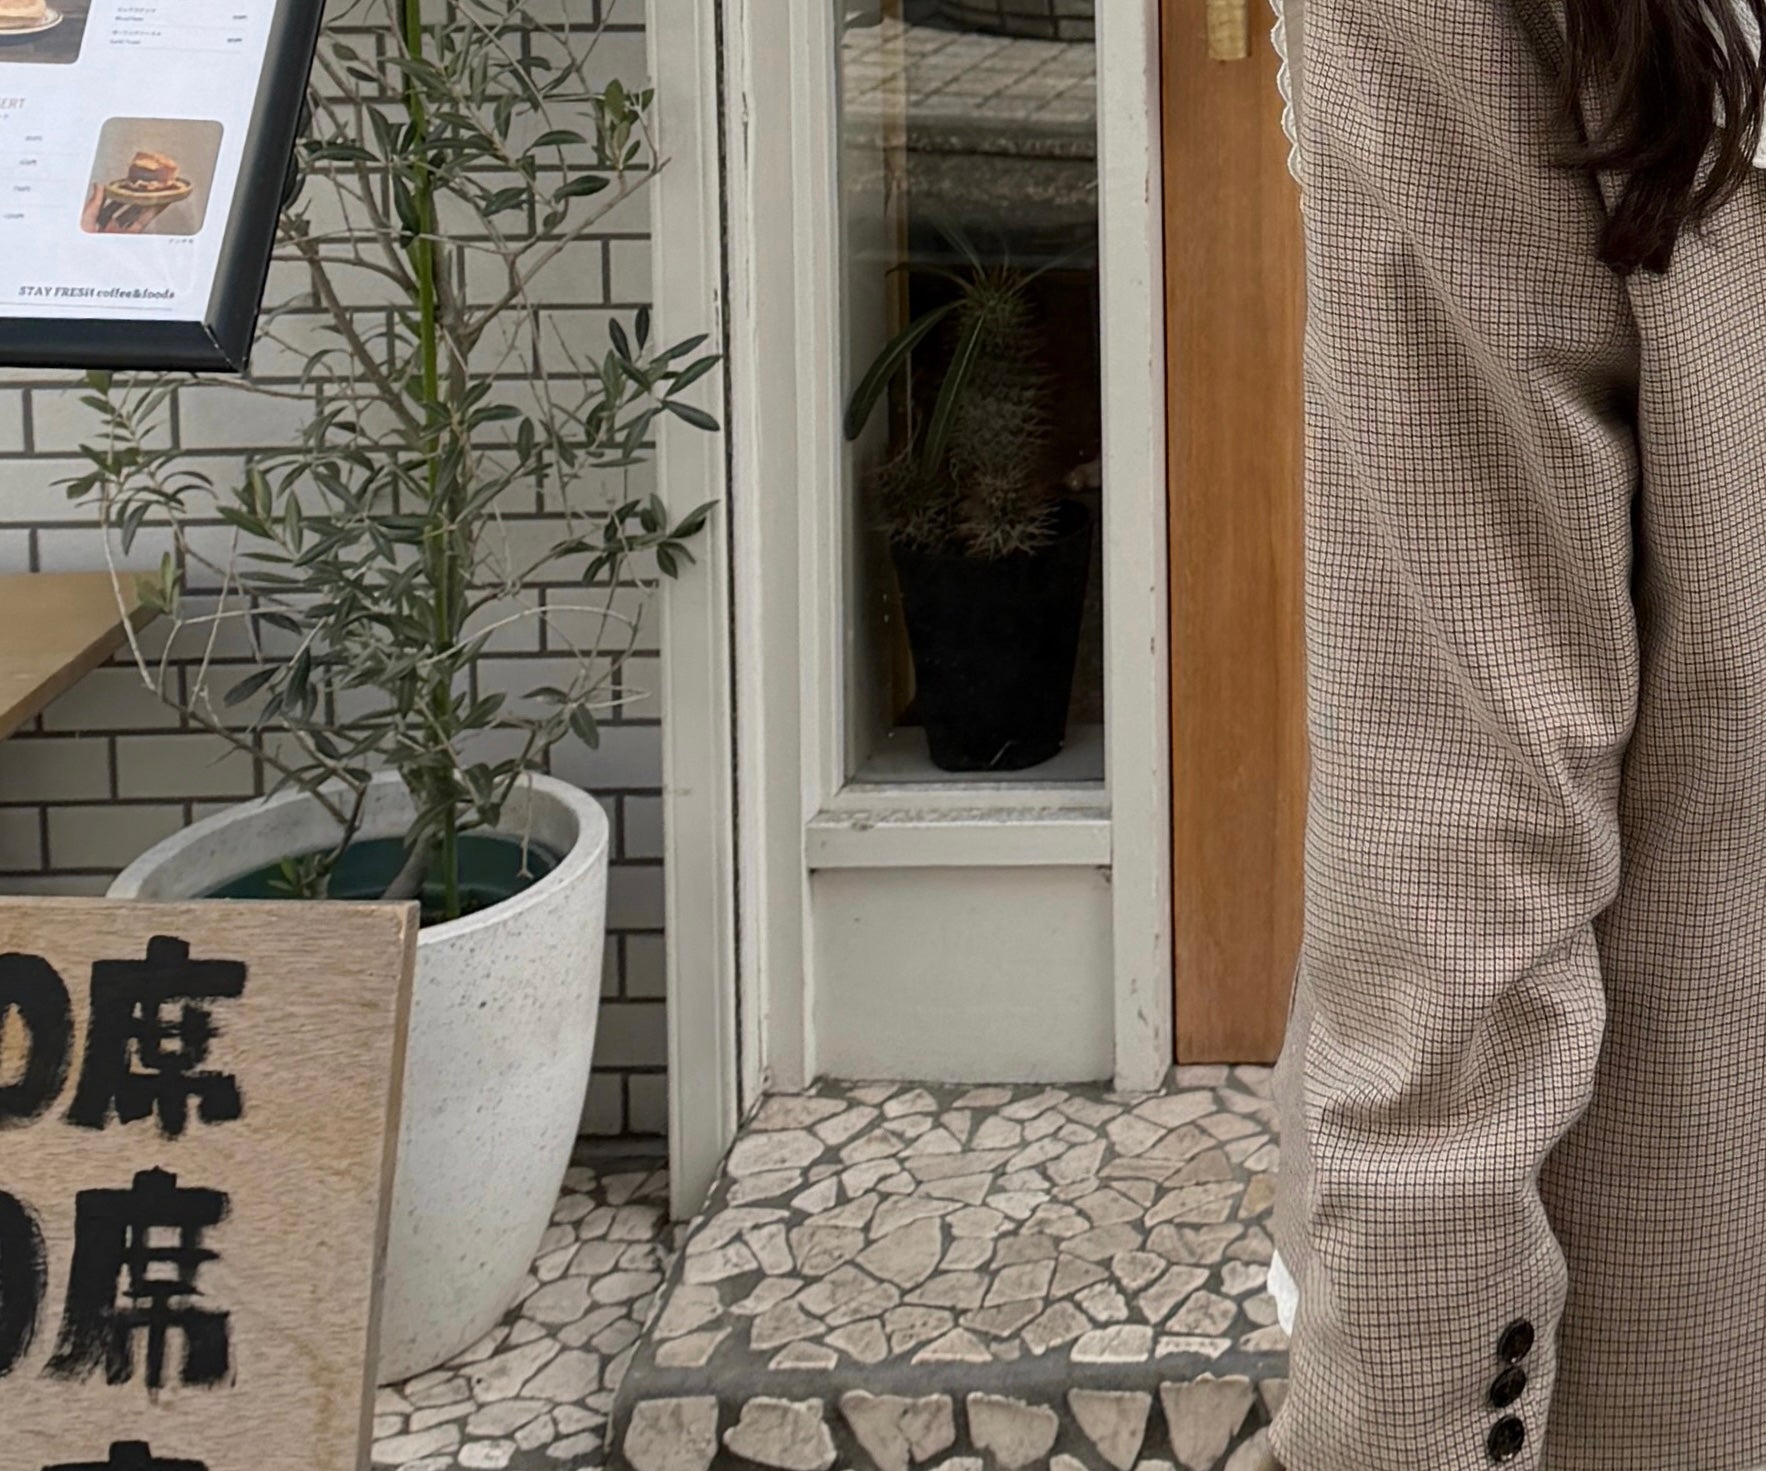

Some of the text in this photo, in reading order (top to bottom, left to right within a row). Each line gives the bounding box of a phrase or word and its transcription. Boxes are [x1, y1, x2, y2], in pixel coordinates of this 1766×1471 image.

[18, 285, 52, 297] STAY
[54, 287, 95, 298] FRESH
[0, 1165, 238, 1405] 席
